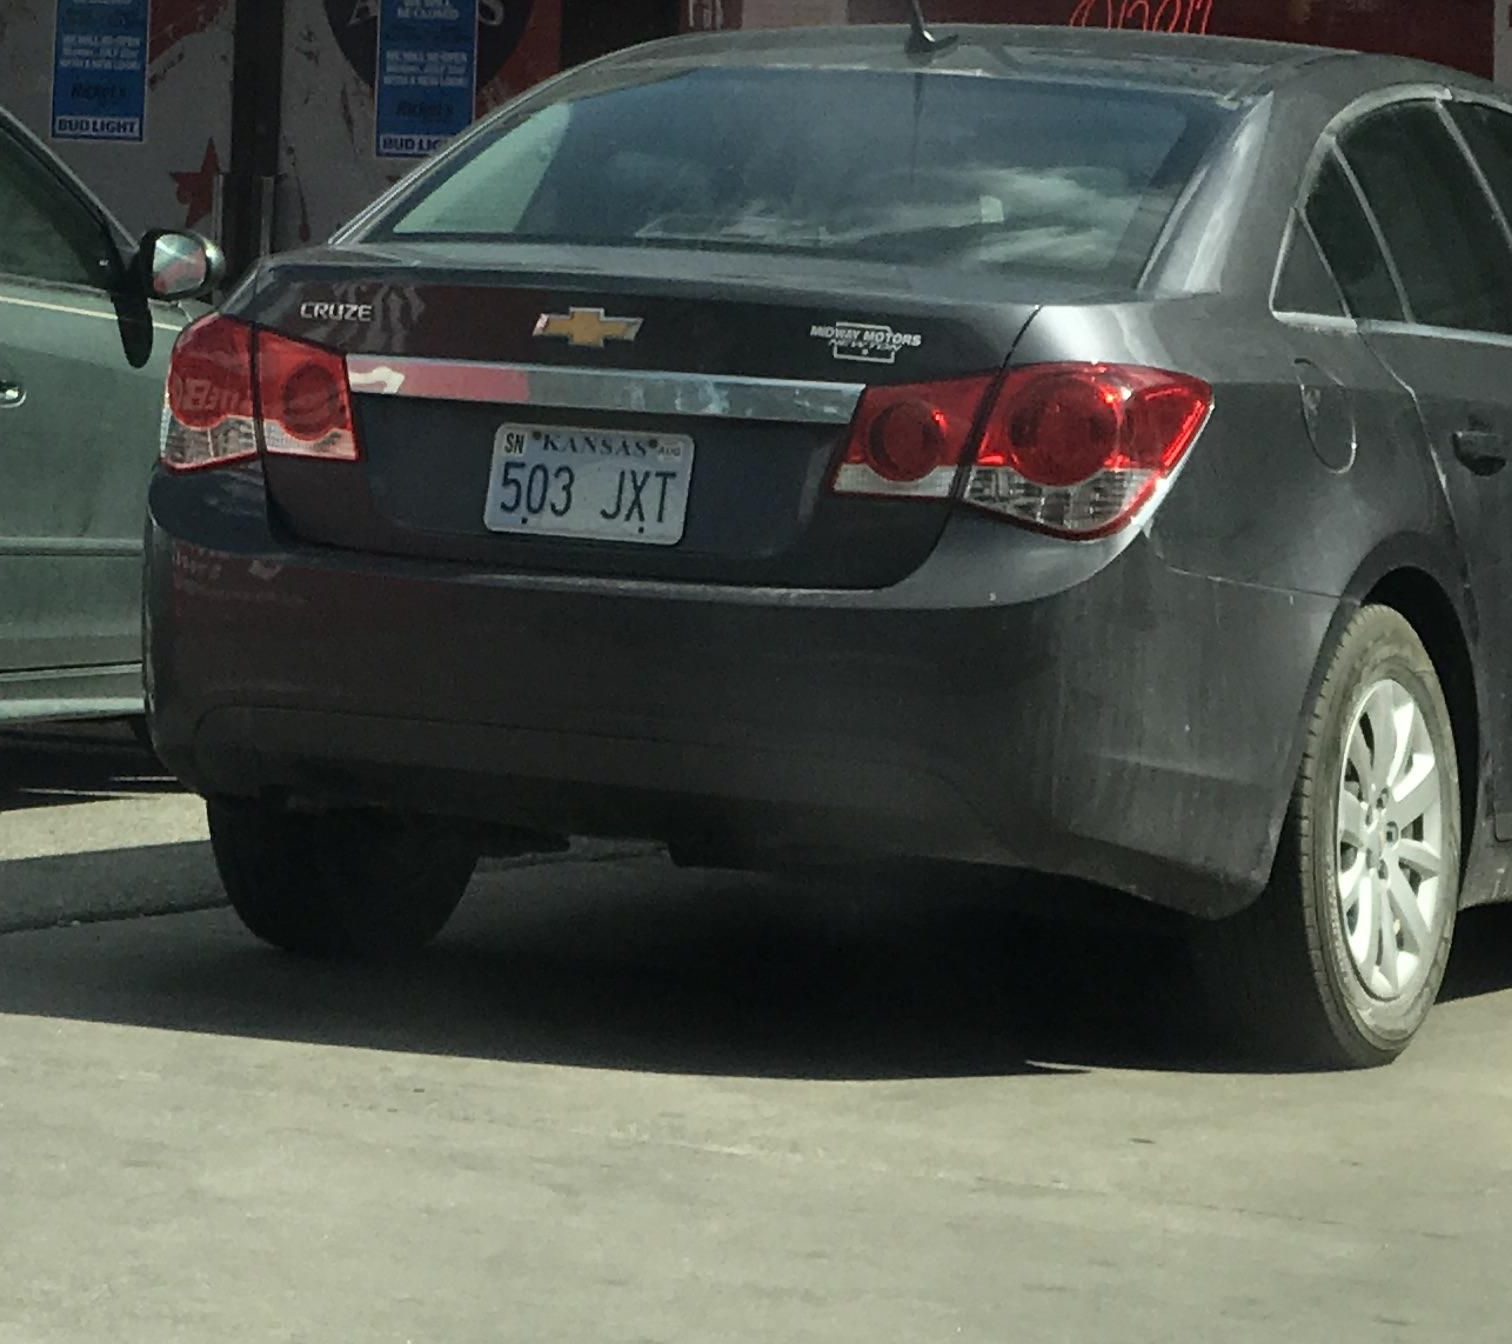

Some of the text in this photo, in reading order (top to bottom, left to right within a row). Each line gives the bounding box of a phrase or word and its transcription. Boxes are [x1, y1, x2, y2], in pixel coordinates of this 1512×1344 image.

[92, 119, 137, 134] LIGHT
[300, 301, 372, 323] CRUZE
[862, 329, 922, 348] MOTORS
[504, 432, 525, 454] SN
[542, 433, 647, 458] KANSAS
[500, 461, 677, 524] 503 JXT
